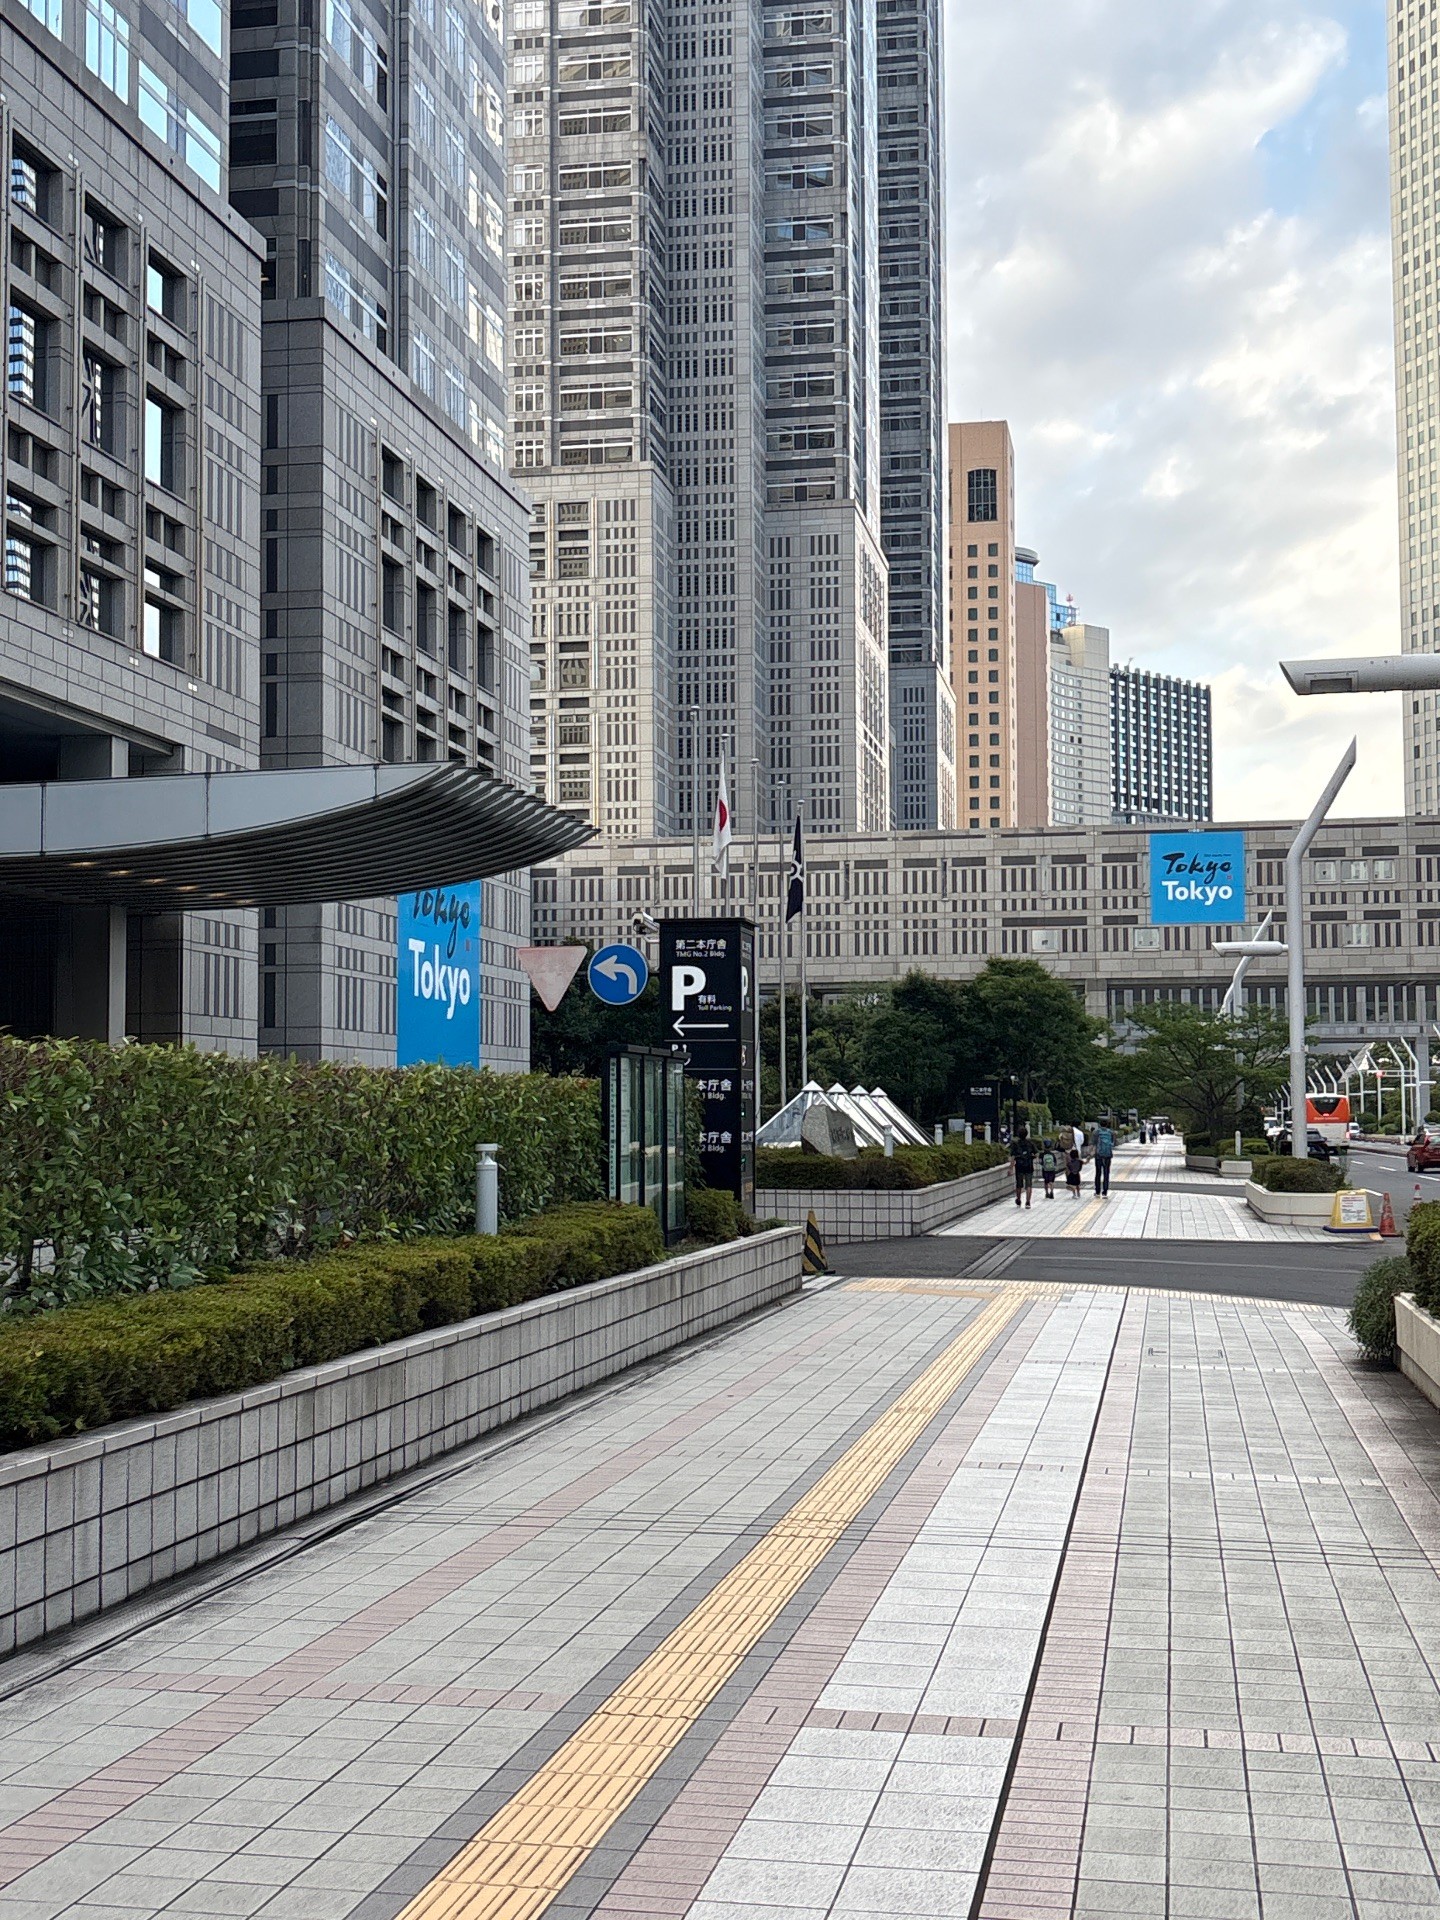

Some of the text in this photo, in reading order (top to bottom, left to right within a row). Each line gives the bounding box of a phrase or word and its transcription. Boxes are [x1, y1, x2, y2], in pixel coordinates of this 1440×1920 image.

[1161, 852, 1232, 885] Tokyo
[1161, 880, 1233, 906] Tokyo
[675, 939, 727, 950] 第二本庁舎
[709, 951, 727, 959] Bldg.
[408, 938, 471, 1020] Tokyo
[672, 965, 707, 1011] P
[697, 994, 716, 1004] 有料
[709, 1004, 732, 1012] Parking
[696, 1078, 732, 1091] 本庁舎
[707, 1092, 726, 1101] Bldg.
[699, 1131, 732, 1144] 本庁舎
[707, 1144, 726, 1154] Bldg.
